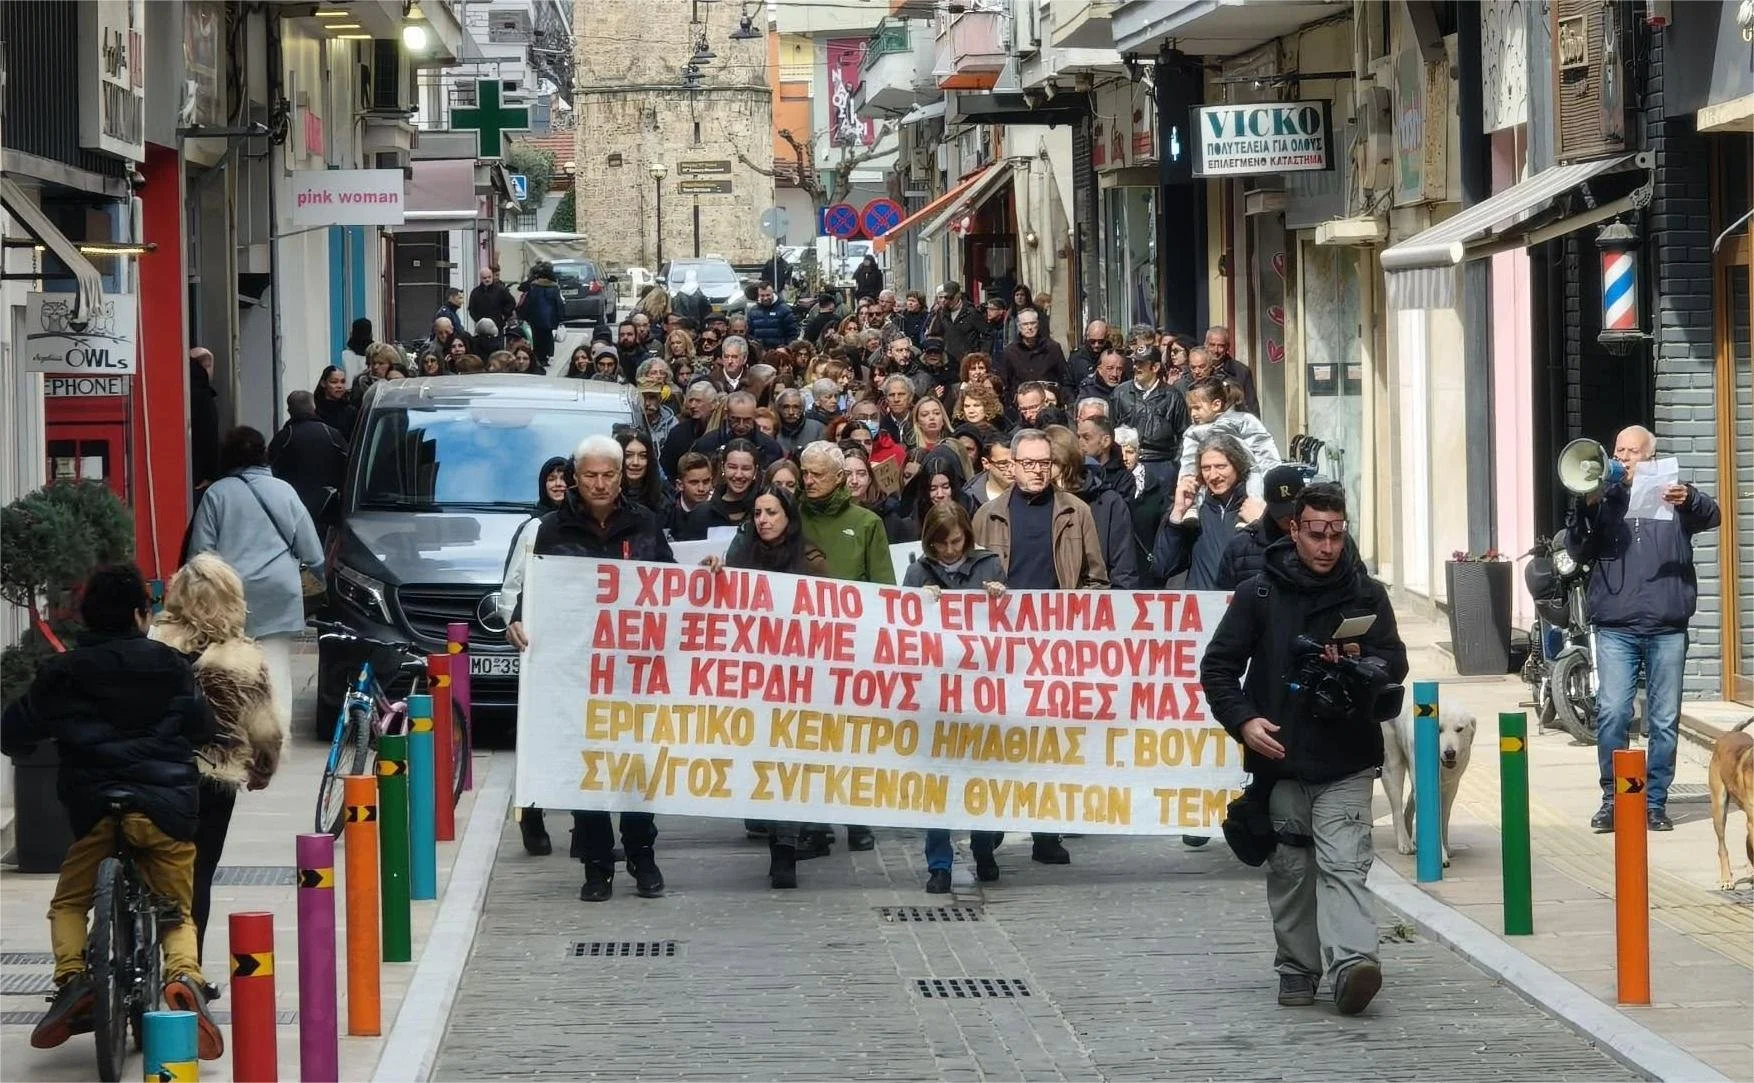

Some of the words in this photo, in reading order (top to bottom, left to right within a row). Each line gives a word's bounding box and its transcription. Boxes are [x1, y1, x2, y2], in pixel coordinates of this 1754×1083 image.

[1205, 106, 1321, 138] VICKO
[1207, 139, 1269, 156] ΠΟΛΥΤΕΛΕΙΑ
[1272, 139, 1289, 152] ΓΙΑ
[1290, 137, 1323, 152] ΟΛΟΥΣ
[1207, 156, 1267, 169] ΕΠΙΛΕΓΜΕΝΟ
[1269, 154, 1323, 167] ΚΑΤΑΣΤΗΜΑ
[297, 188, 333, 208] pink
[338, 192, 398, 204] woman
[65, 348, 129, 370] OWLs
[1279, 484, 1292, 498] R
[595, 564, 620, 604] 3
[636, 566, 774, 612] ΧΡΟΝΙΑ
[792, 578, 863, 619] ΑΠΟ
[878, 588, 924, 627] ΤΟ
[939, 593, 1116, 632] ΕΓΚΛΗΜΑ
[1131, 593, 1204, 633] ΣΤΑ
[592, 609, 667, 652] ΔΕΝ
[679, 611, 856, 662] ΞΕΧΝΑΜΕ
[873, 627, 944, 668] ΔΕΝ
[958, 635, 1197, 678] ΣΥΓΧΩΡΟΥΜΕ
[588, 653, 616, 696] Η
[627, 655, 672, 696] ΤΑ
[688, 657, 814, 705] ΚΕΡΔΗ
[829, 668, 923, 712] ΤΟΥΣ
[938, 674, 964, 714] Η
[973, 676, 1007, 717] ΟΙ
[1024, 680, 1119, 721] ΖΩΕΣ
[1130, 682, 1206, 721] ΜΑΣ
[584, 698, 755, 748] ΕΡΓΑΤΙΚΟ
[768, 708, 920, 758] ΚΕΝΤΡΟ
[931, 722, 1087, 766] ΗΜΑΘΙΑΣ
[1105, 726, 1244, 768] Γ.ΒΟΥΤ
[579, 746, 734, 802] ΣΥΛ/ΓΟΣ
[750, 760, 950, 814] ΣΥΓΚΕΝΩΝ
[963, 778, 1132, 825] ΘΥΜΑΤΩΝ
